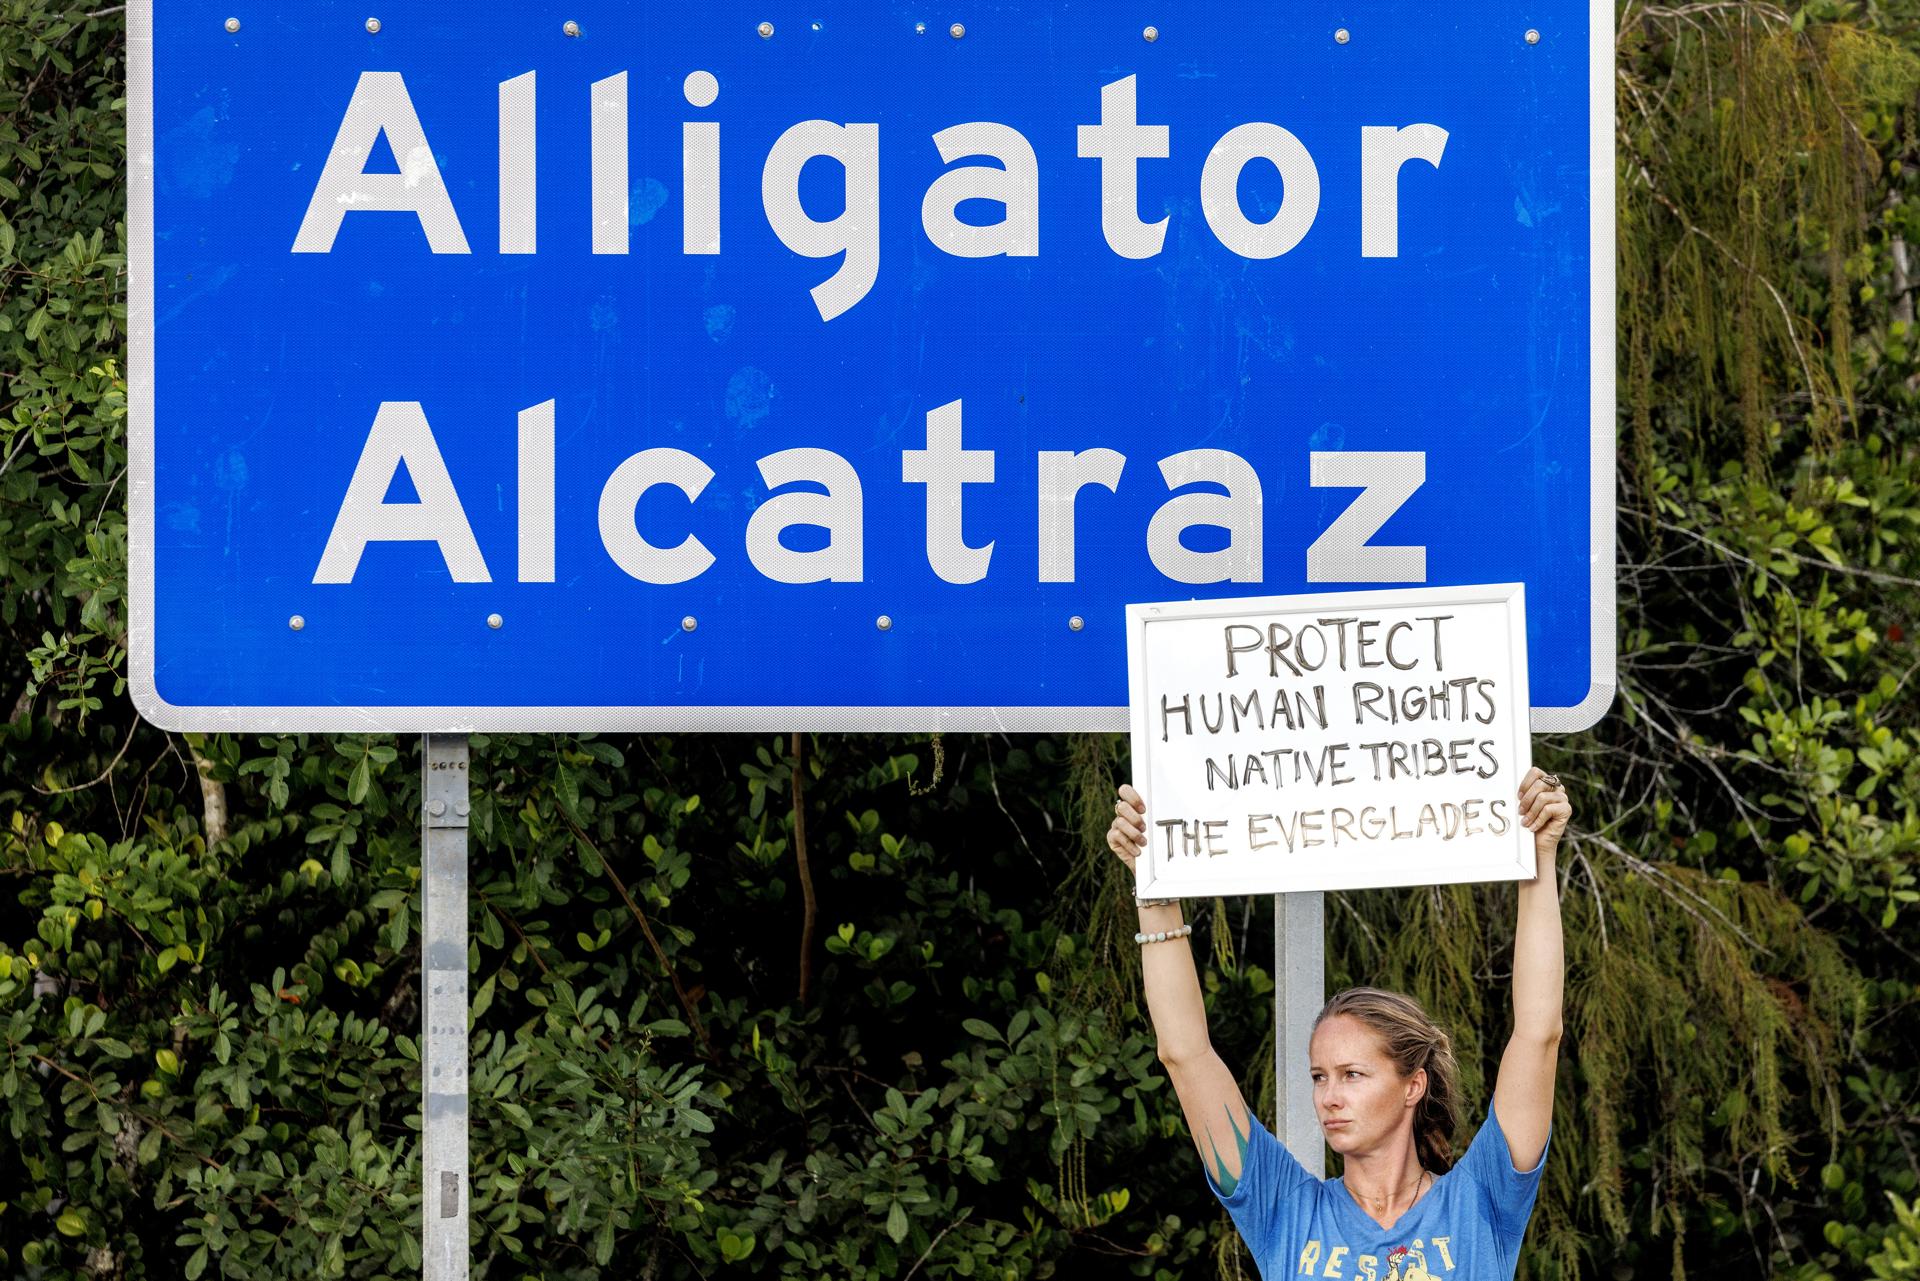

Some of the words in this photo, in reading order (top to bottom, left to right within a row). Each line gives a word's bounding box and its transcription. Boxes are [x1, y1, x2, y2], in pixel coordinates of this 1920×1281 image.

[291, 70, 1449, 322] Alligator
[312, 398, 1427, 585] Alcatraz
[1223, 614, 1455, 679] PROTECT
[1160, 684, 1329, 743] HUMAN
[1351, 676, 1497, 726] RIGHTS
[1205, 742, 1355, 792] NATIVE
[1359, 737, 1500, 782] TRIBES
[1156, 817, 1229, 863] THE
[1247, 798, 1511, 854] EVERGLADES
[1297, 1235, 1456, 1281] RESST
